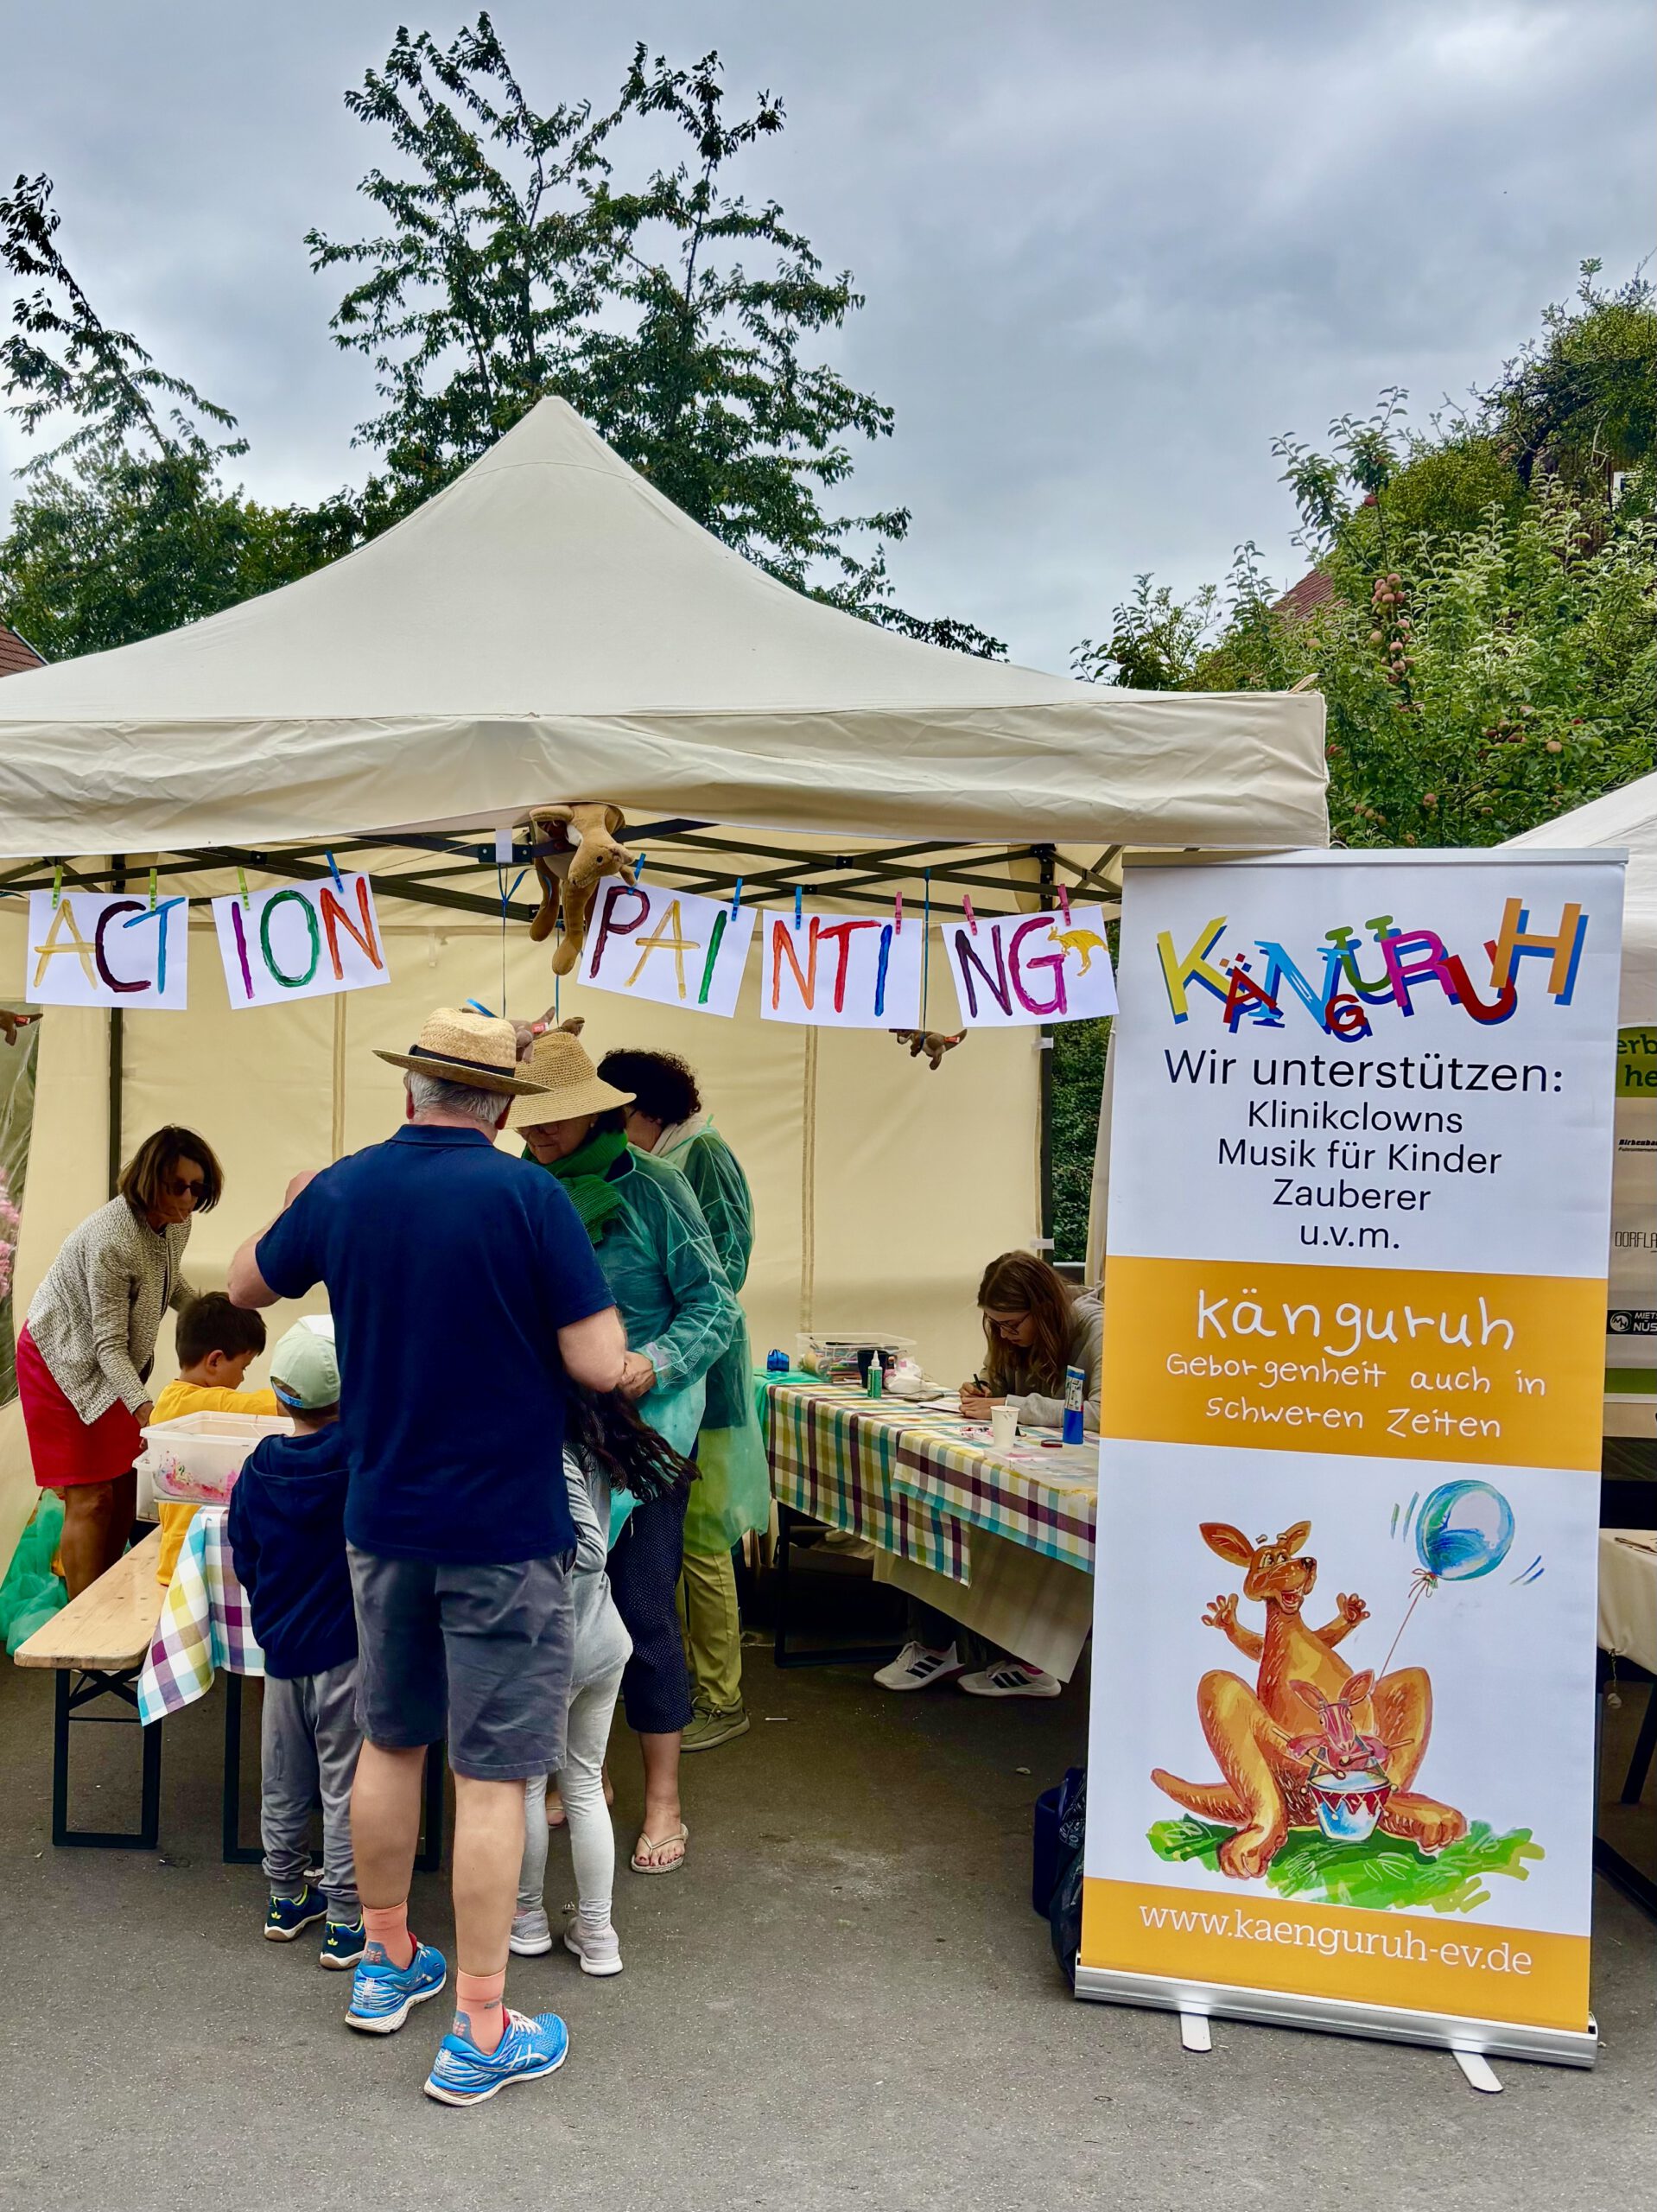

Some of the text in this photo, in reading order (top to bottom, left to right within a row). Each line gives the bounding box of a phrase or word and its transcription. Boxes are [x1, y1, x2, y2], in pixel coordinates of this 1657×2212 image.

[1164, 1048, 1563, 1093] Wir unterstützen:
[1248, 1099, 1463, 1134] Klinikclowns
[1218, 1138, 1502, 1175] Musik für Kinder
[1272, 1178, 1432, 1211] Zauberer
[1300, 1224, 1400, 1249] u.v.m.
[1166, 1353, 1546, 1395] Geborgenheit auch in
[1387, 1408, 1501, 1438] Zeiten
[1140, 1905, 1532, 1975] www.kaenguruh-ev.de
